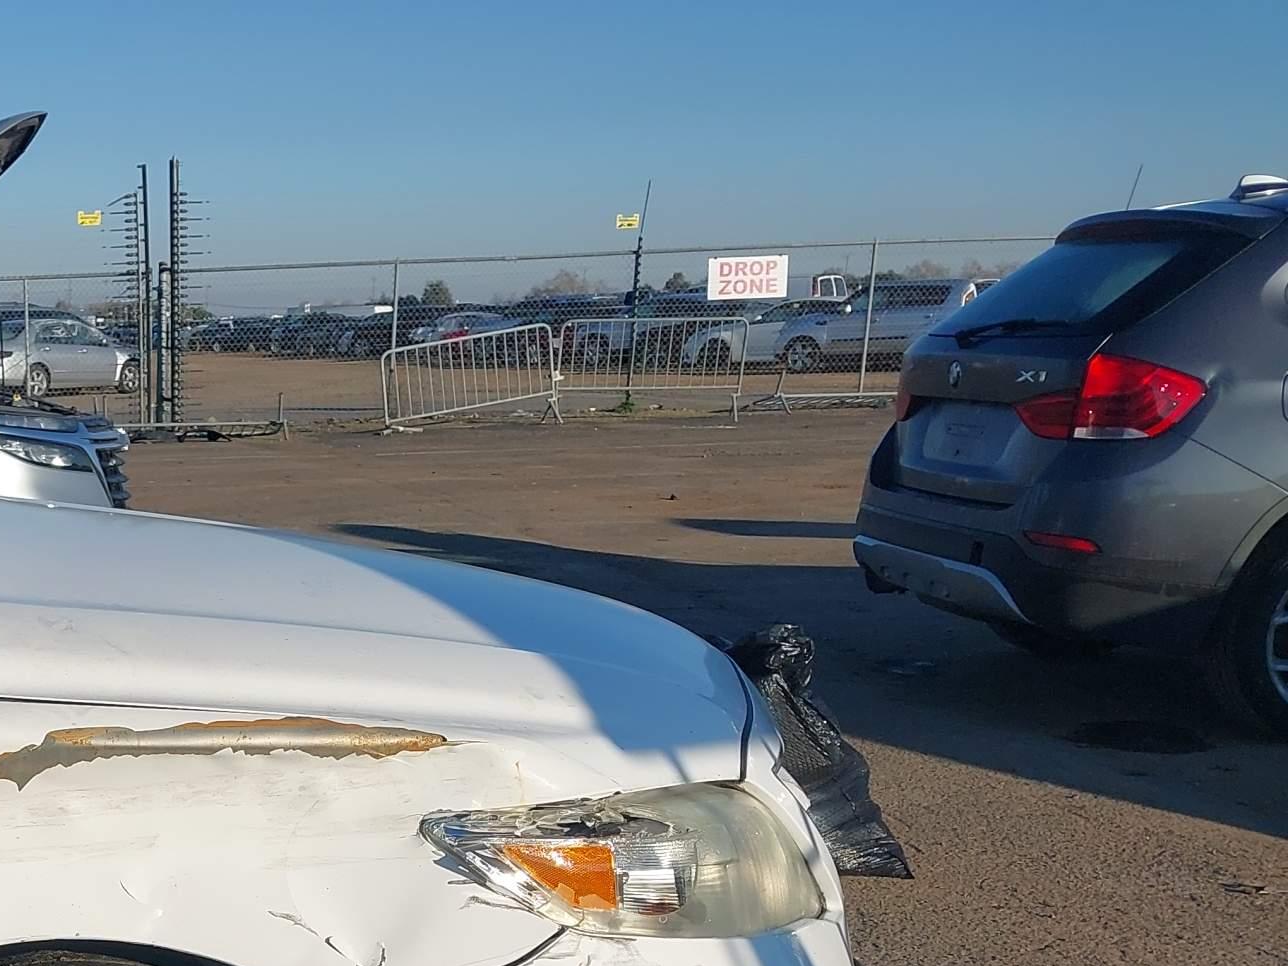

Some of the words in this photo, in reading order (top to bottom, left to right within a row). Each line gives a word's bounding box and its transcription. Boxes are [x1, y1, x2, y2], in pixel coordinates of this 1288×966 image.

[719, 260, 778, 278] DROP
[718, 278, 778, 296] ZONE
[1015, 370, 1047, 383] X1
